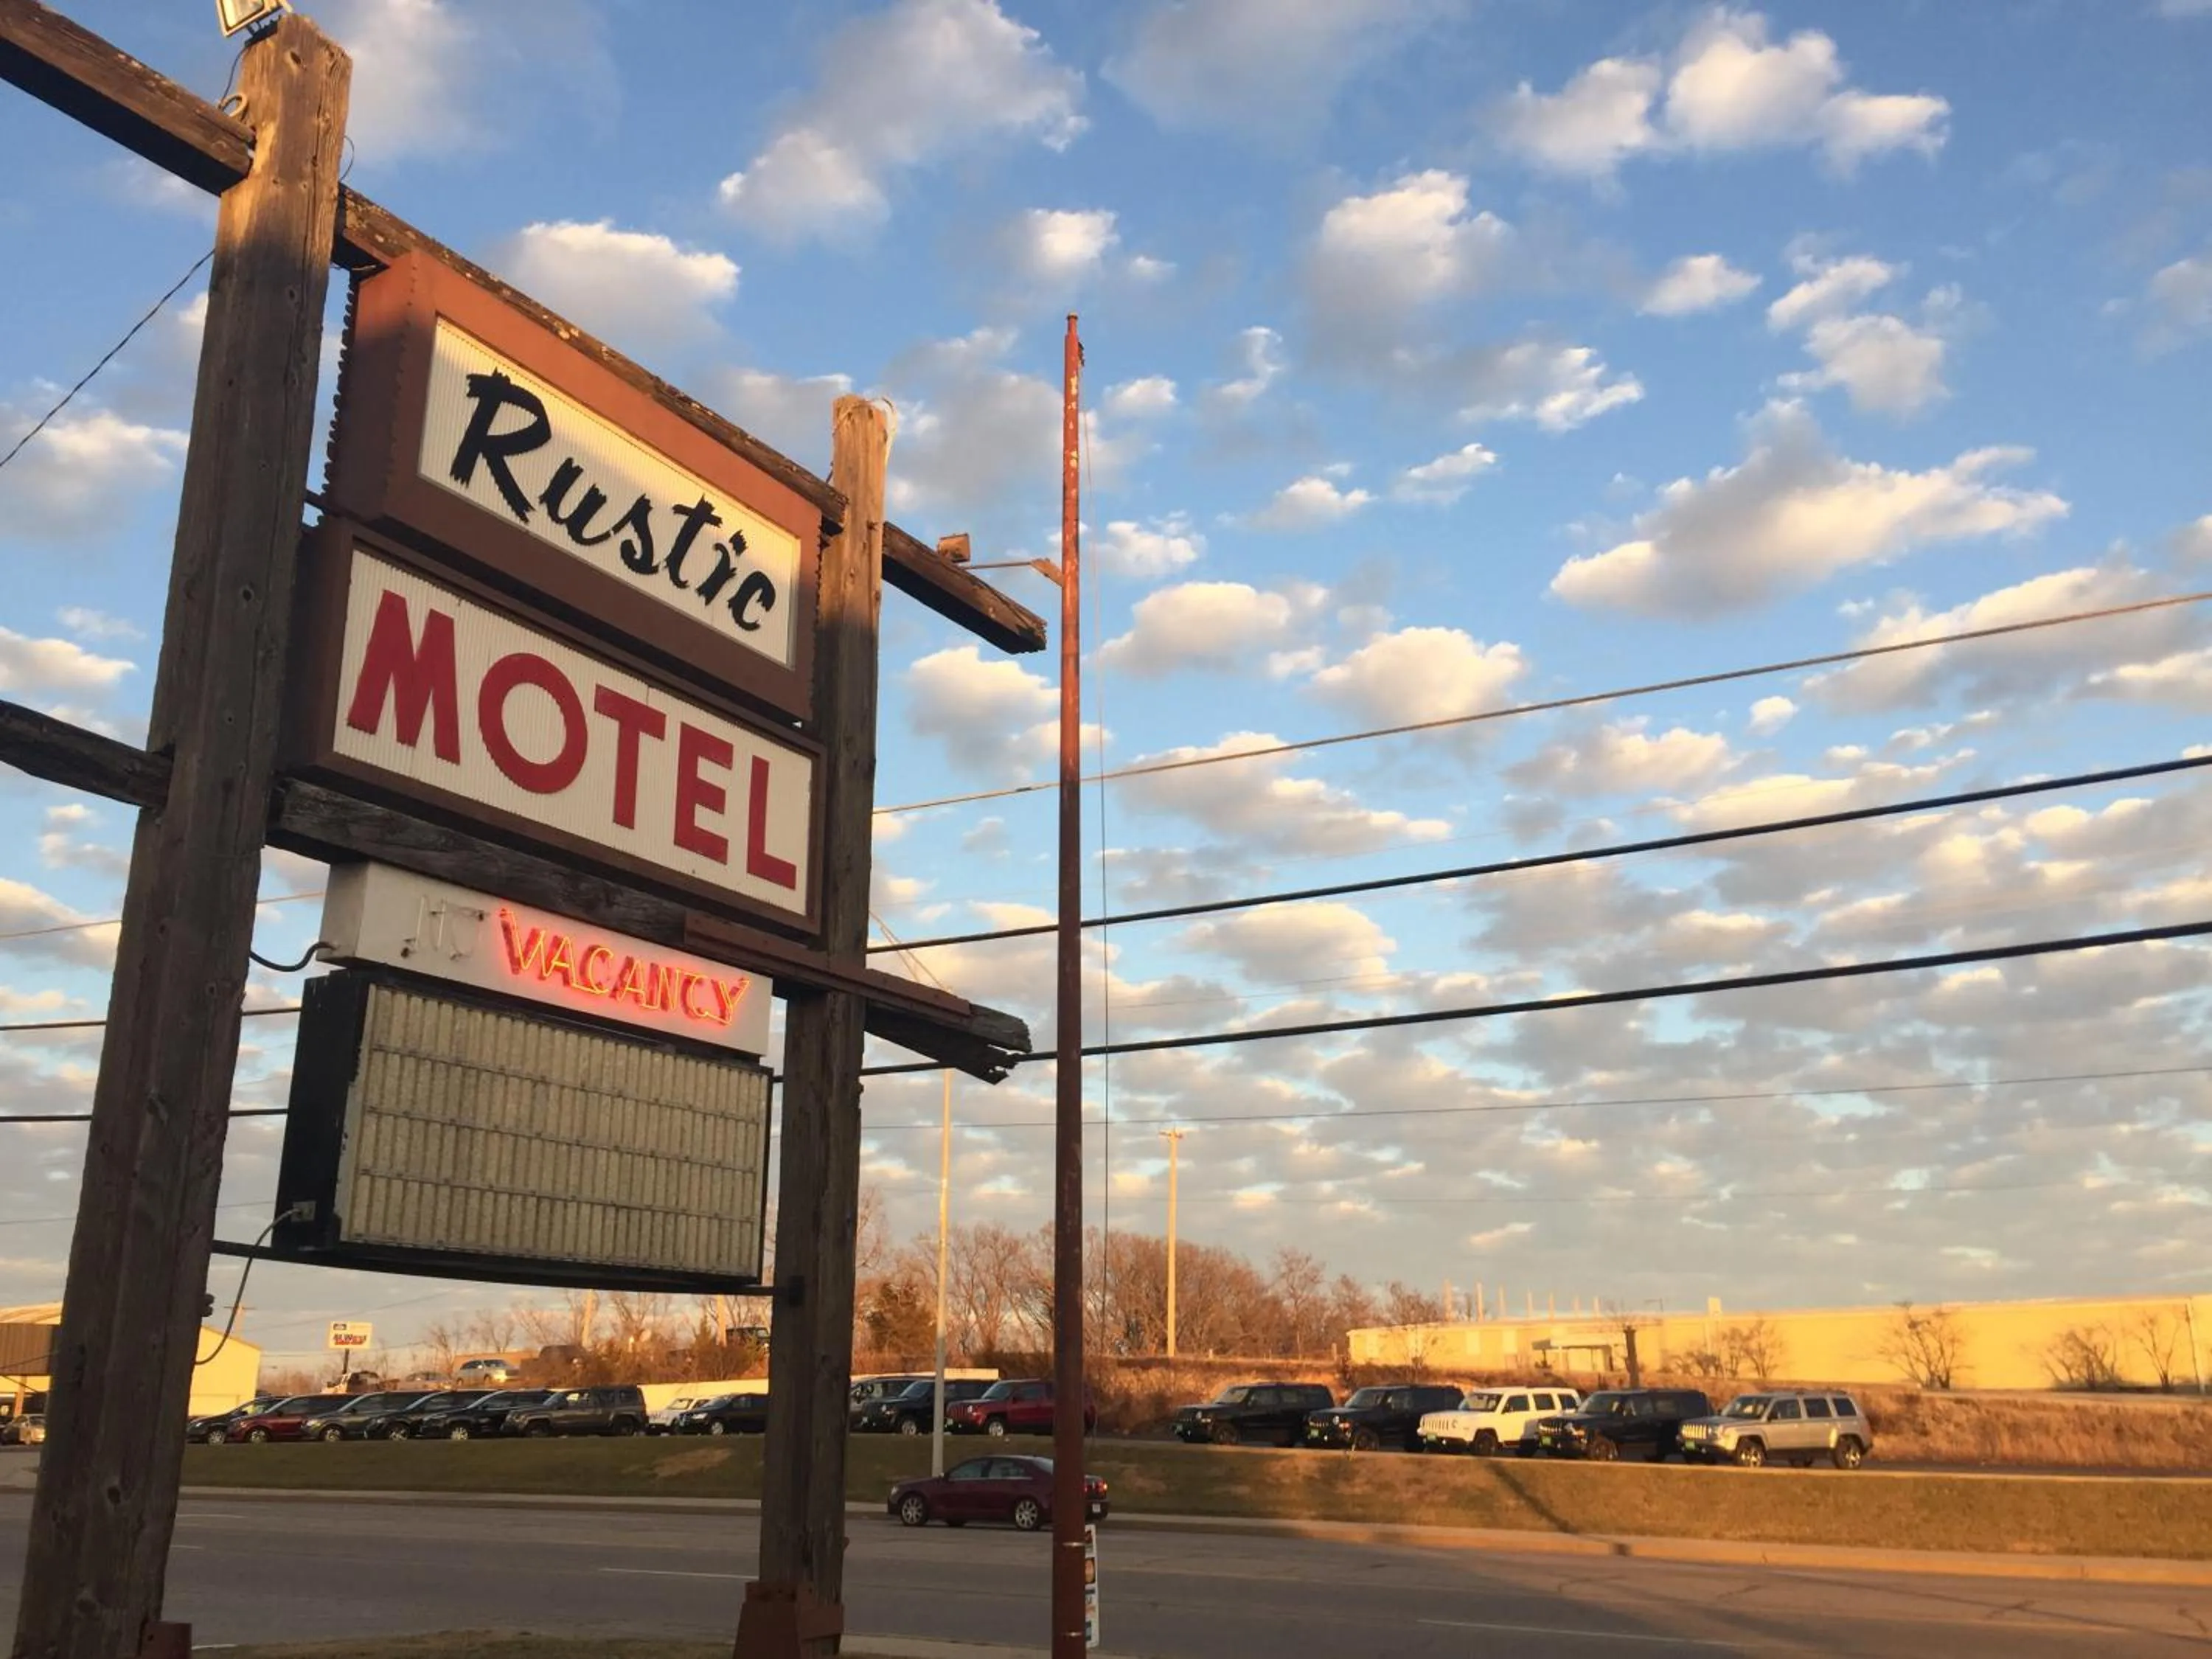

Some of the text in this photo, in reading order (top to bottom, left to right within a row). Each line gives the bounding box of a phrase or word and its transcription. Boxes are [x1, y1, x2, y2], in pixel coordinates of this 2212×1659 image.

[450, 369, 776, 632] Rustic
[347, 589, 796, 891] MOTEL
[500, 908, 750, 1026] VACANCY
